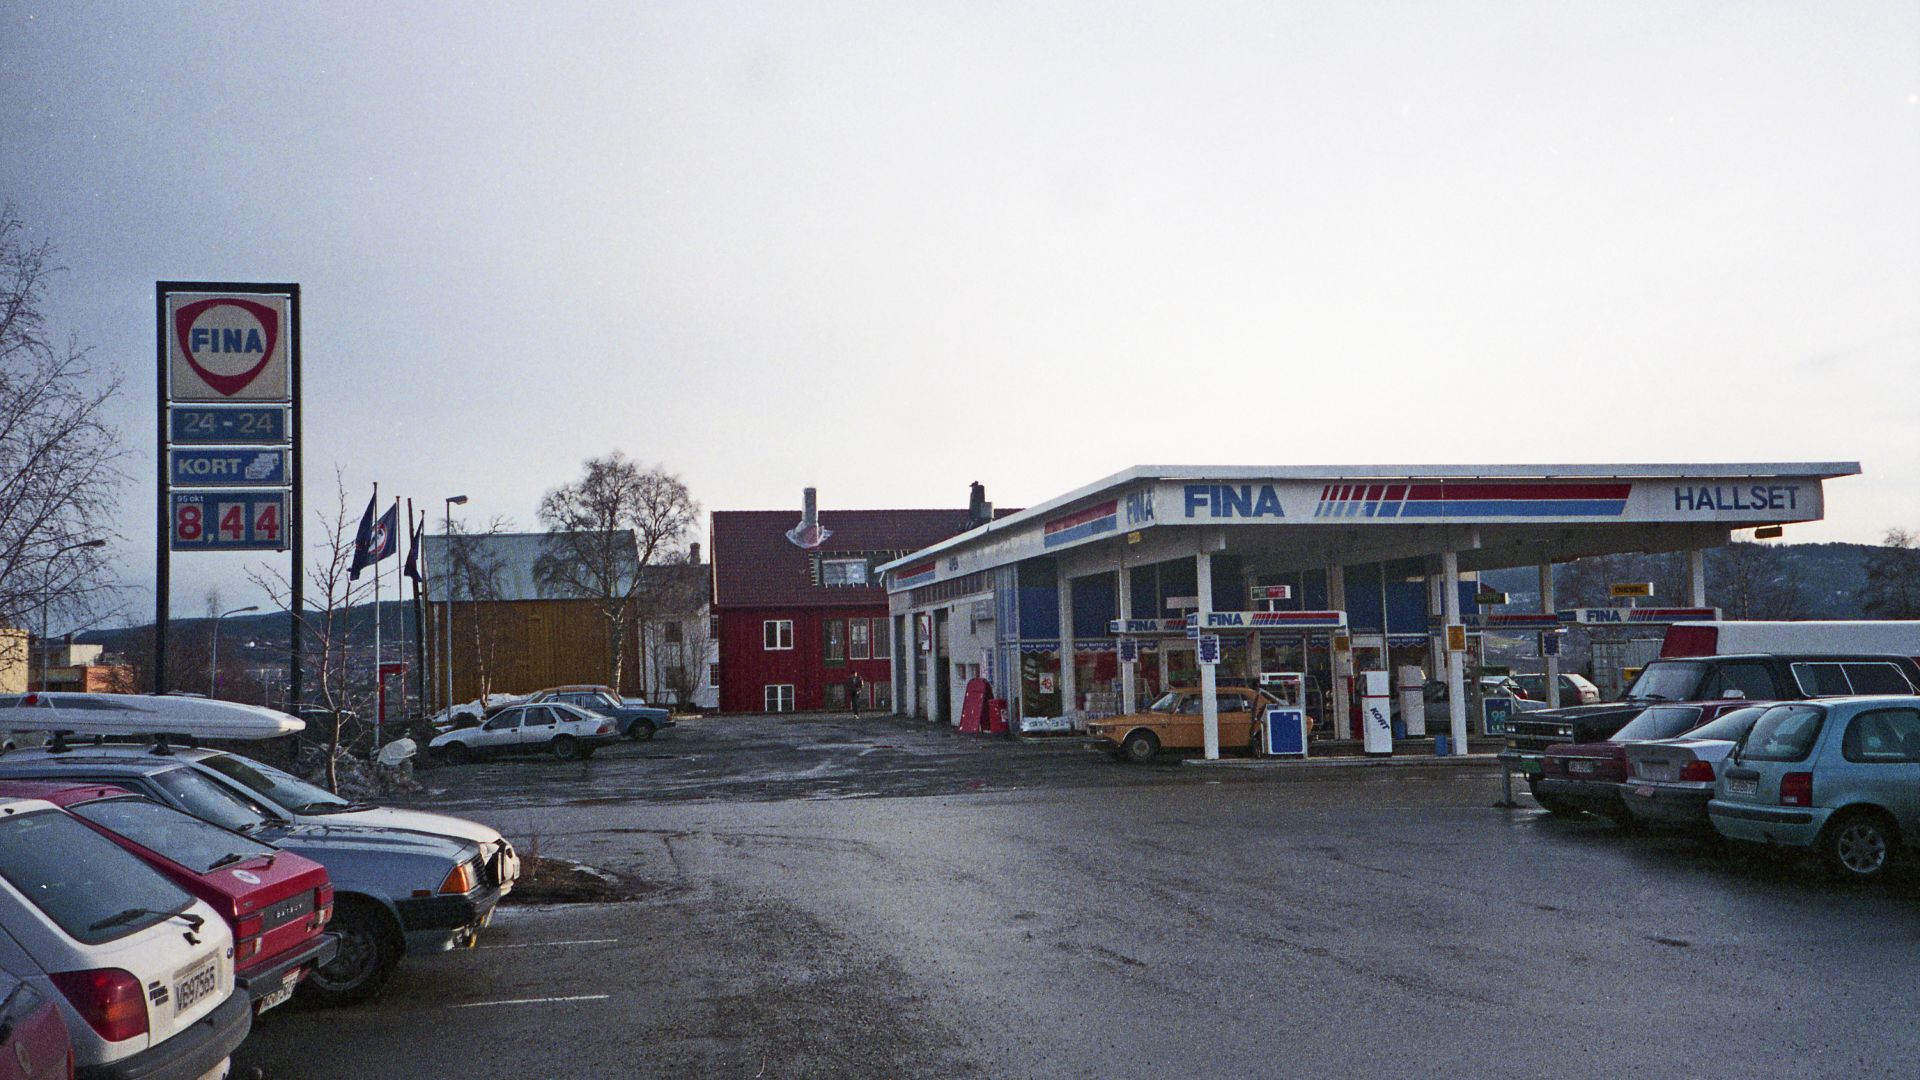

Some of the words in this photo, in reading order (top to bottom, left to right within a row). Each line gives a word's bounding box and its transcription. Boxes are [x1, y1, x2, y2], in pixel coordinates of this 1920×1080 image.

[191, 328, 264, 353] FINA
[178, 458, 242, 475] KORT
[1126, 487, 1155, 526] FINA
[1183, 485, 1285, 518] FINA
[1674, 486, 1800, 511] HALLSET
[178, 505, 280, 544] 8,44
[1126, 620, 1159, 632] FINA
[1208, 613, 1244, 626] FINA
[1585, 610, 1622, 622] FINA
[1370, 707, 1390, 730] KORT
